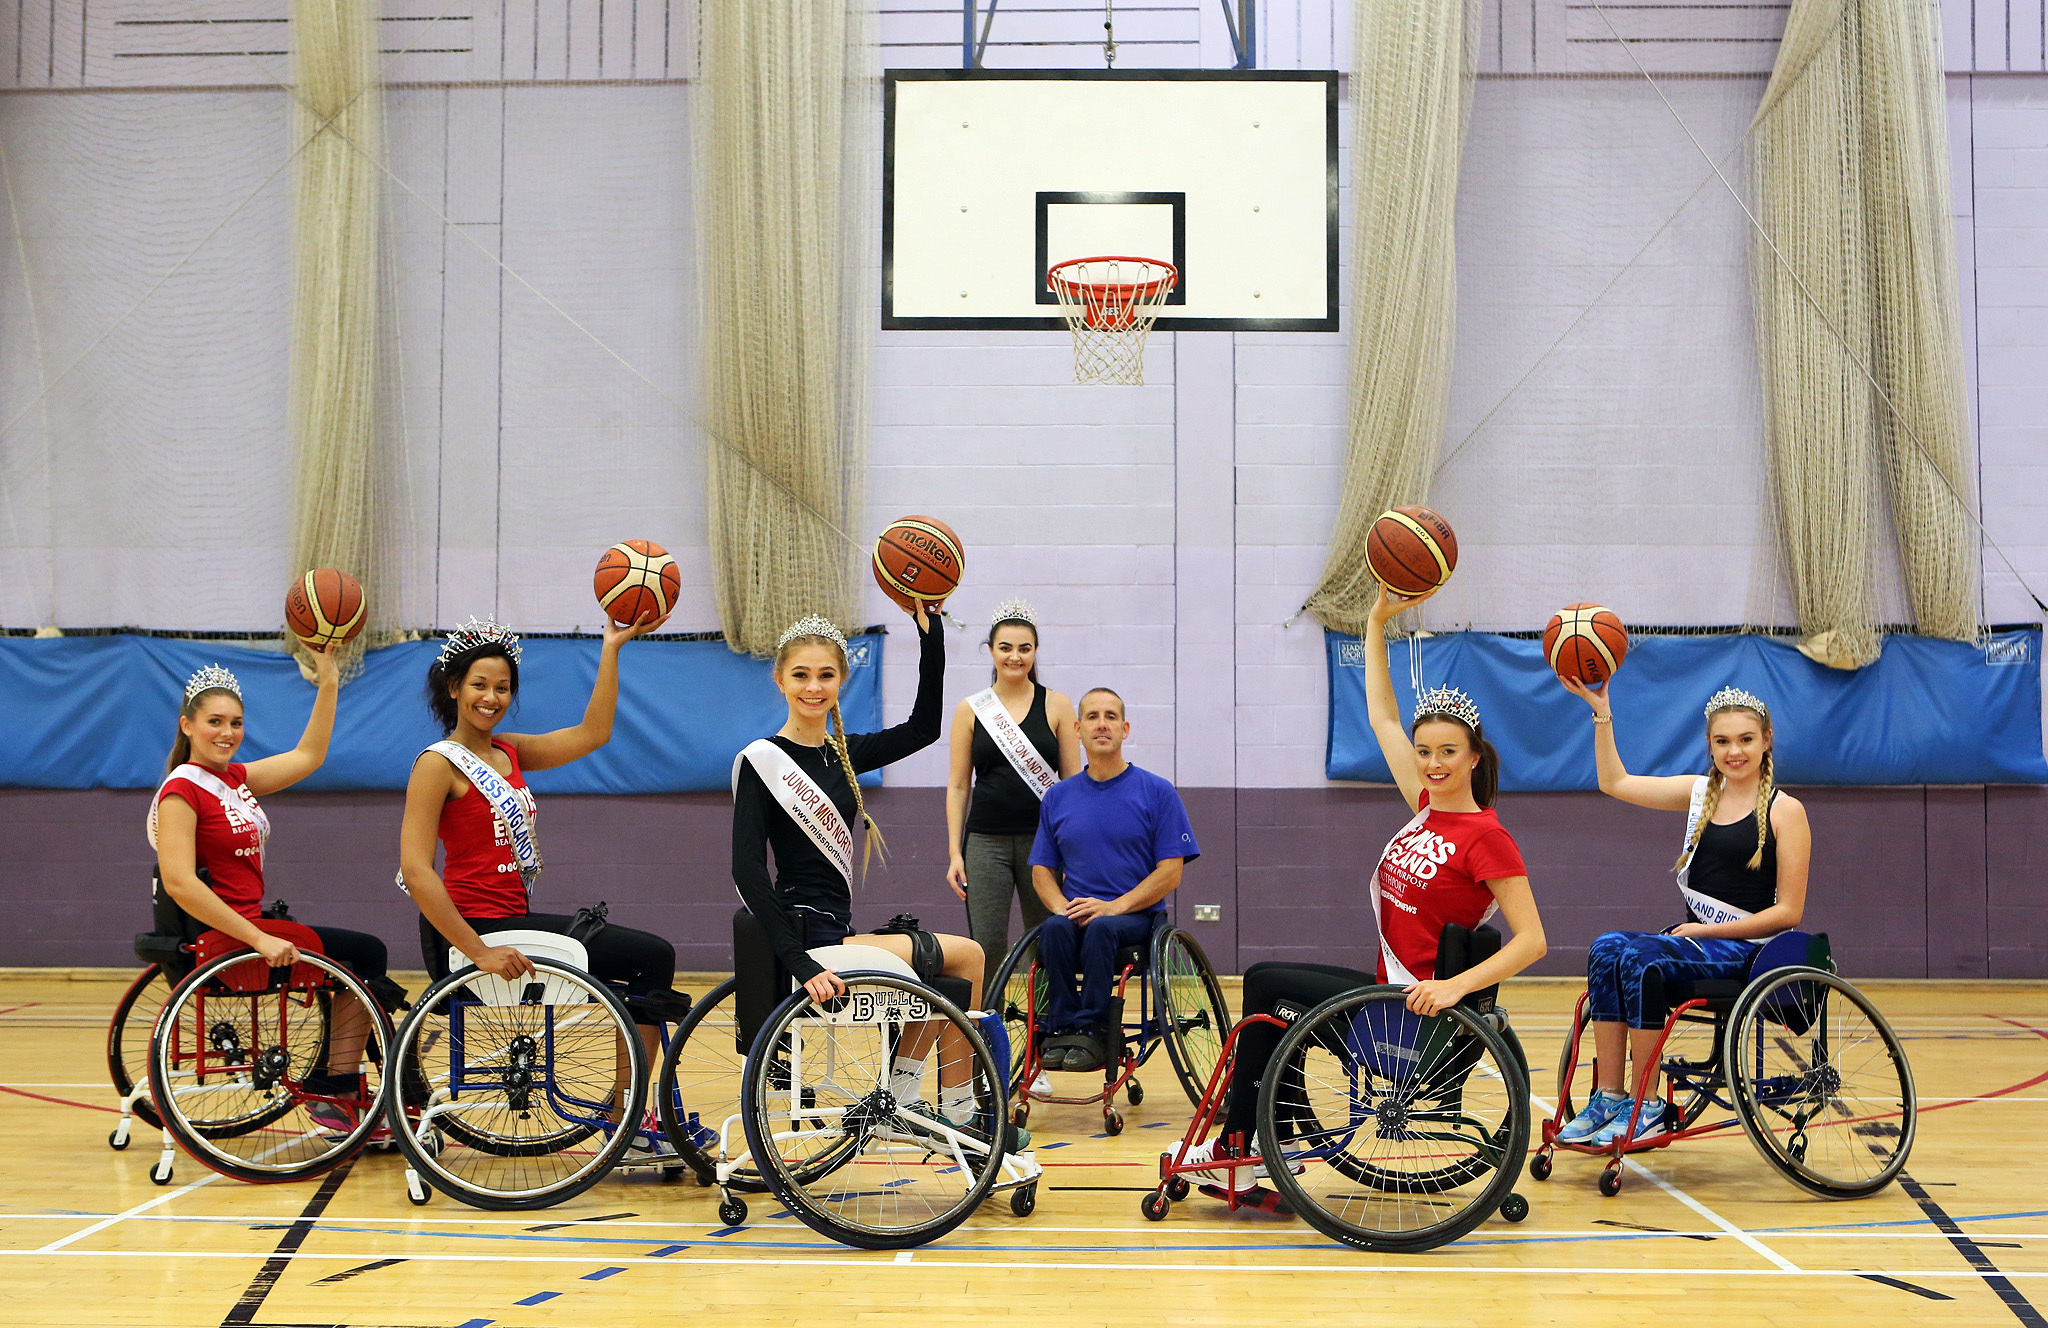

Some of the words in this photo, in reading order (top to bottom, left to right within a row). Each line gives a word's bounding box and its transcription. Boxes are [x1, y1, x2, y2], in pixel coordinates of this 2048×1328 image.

[899, 530, 952, 569] molten
[905, 543, 938, 567] OFFICIAL
[992, 712, 1010, 730] MISS
[1003, 727, 1030, 759] BOLTON
[1024, 757, 1043, 775] AND
[471, 766, 506, 799] MISS
[499, 796, 533, 861] ENGLAND
[782, 771, 820, 810] JUNIOR
[813, 802, 837, 832] MISS
[1694, 901, 1715, 919] AND
[852, 985, 929, 1022] BULLS
